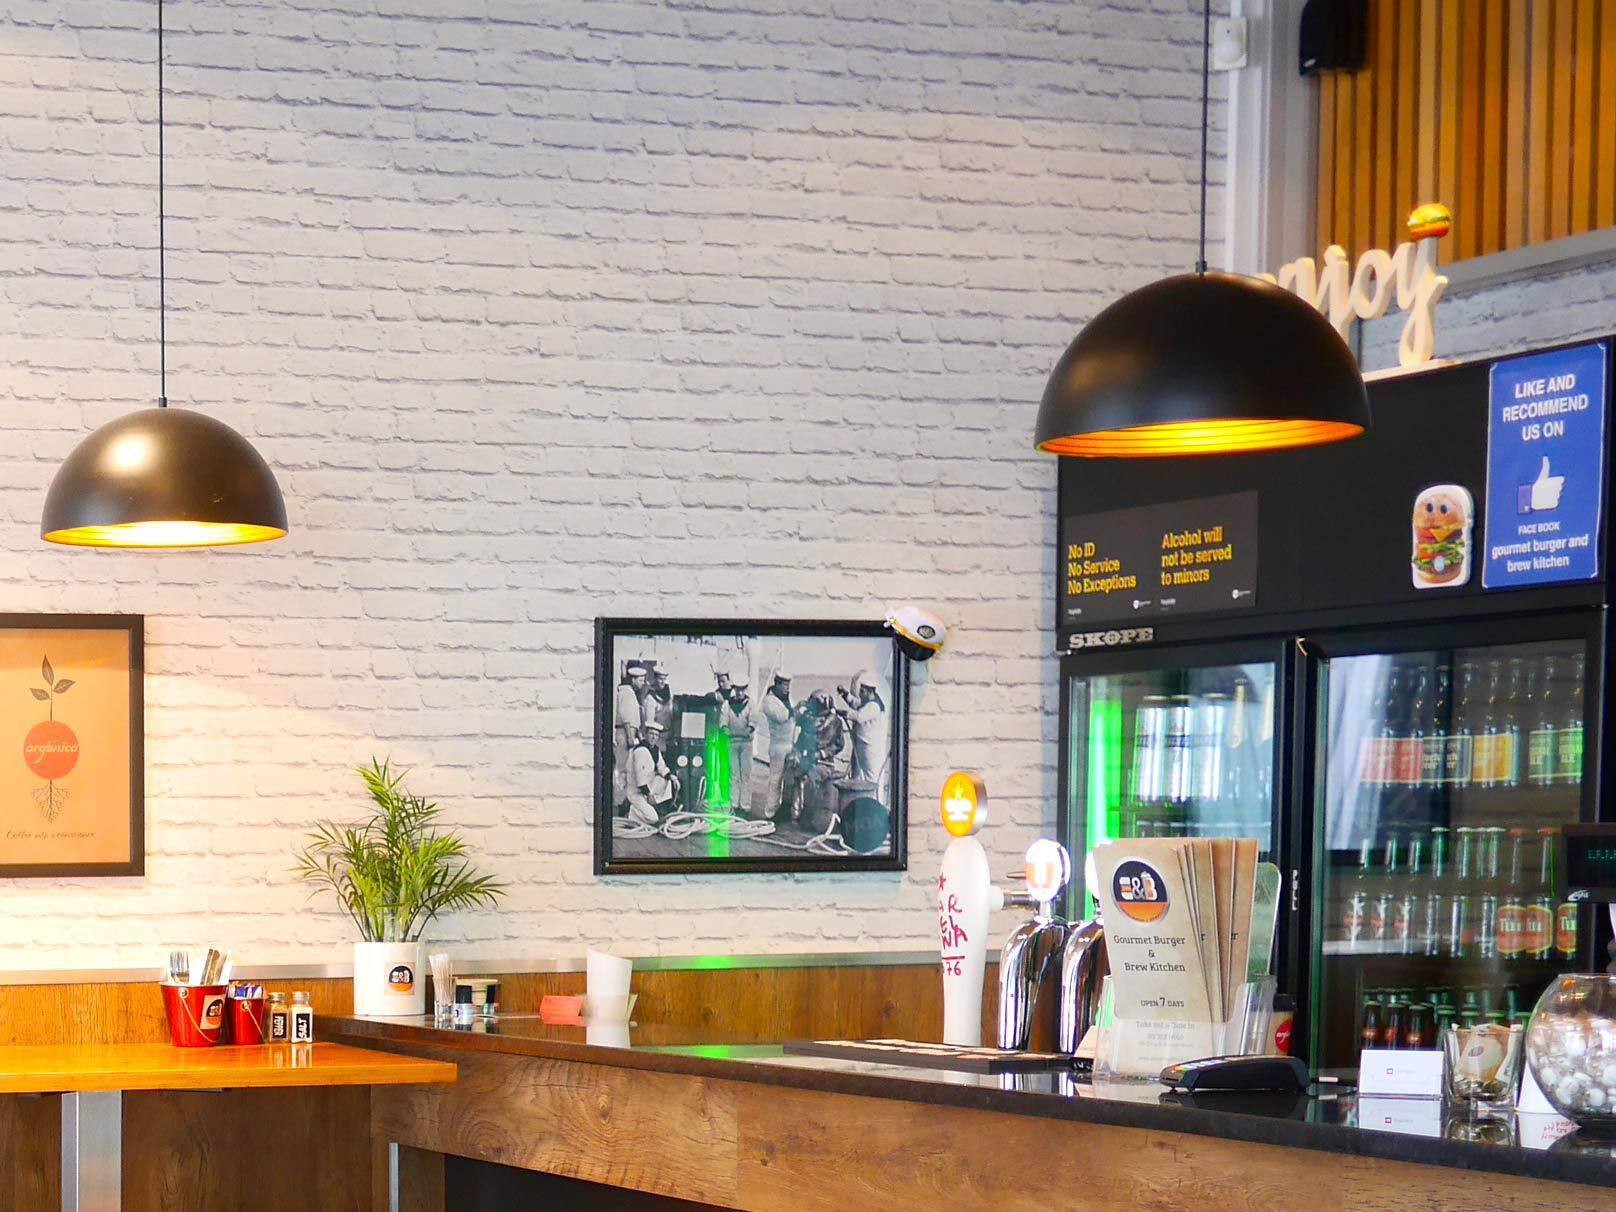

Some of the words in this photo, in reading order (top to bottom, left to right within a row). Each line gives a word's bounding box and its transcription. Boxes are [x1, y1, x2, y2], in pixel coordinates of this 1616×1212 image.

[1257, 240, 1449, 369] njoy
[1515, 379, 1546, 398] LIKE
[1547, 374, 1576, 393] AND
[1502, 394, 1588, 422] RECOMMEND
[1522, 425, 1540, 441] US
[1543, 421, 1563, 438] ON
[1162, 529, 1202, 549] Alcohol
[1204, 526, 1223, 544] will
[1518, 524, 1536, 535] FACE
[1537, 521, 1560, 533] BOOK
[1068, 544, 1083, 559] No
[1084, 542, 1096, 557] ID
[1161, 551, 1179, 568] not
[1180, 549, 1194, 566] be
[1196, 543, 1233, 563] served
[1492, 541, 1531, 559] gourmet
[1533, 536, 1566, 554] burger
[1568, 533, 1589, 548] and
[1068, 562, 1082, 577] No
[1083, 558, 1120, 575] Service
[1507, 560, 1531, 573] brew
[1533, 555, 1569, 569] kitchen
[1068, 580, 1082, 594] No
[1083, 574, 1136, 594] Exceptions
[1161, 571, 1172, 586] to
[1173, 568, 1210, 584] minors
[1069, 627, 1154, 649] SKOPE
[1113, 935, 1152, 946] Gourmet
[1154, 935, 1186, 947] Burger
[1148, 949, 1156, 958] &
[942, 960, 962, 977] 76
[1124, 962, 1148, 972] Brew
[1150, 962, 1186, 972] Kitchen
[1159, 997, 1166, 1007] 7
[298, 1018, 307, 1038] SALT
